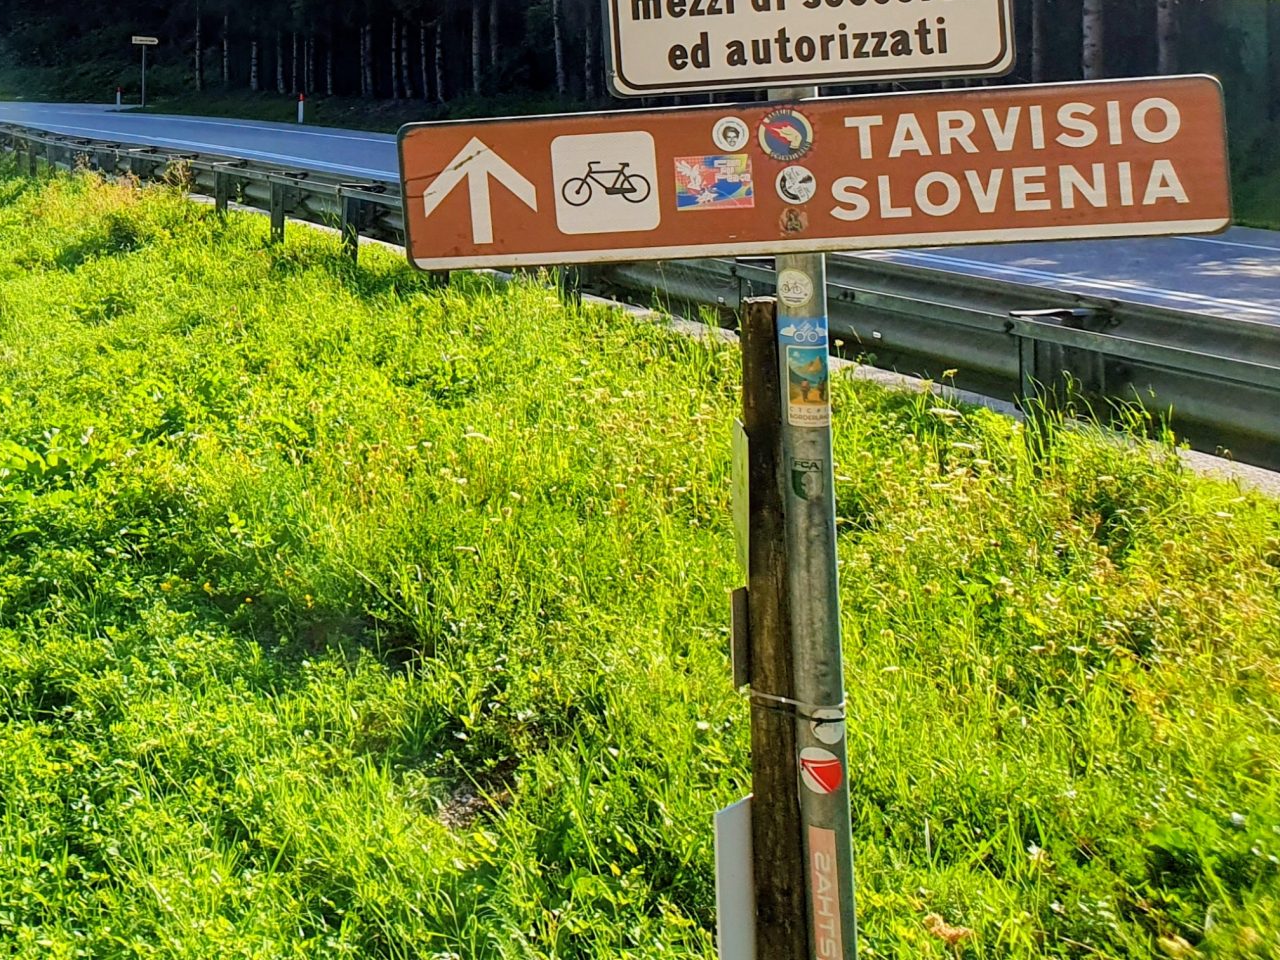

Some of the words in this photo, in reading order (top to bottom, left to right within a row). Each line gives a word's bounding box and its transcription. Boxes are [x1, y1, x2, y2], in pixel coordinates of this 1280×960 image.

[667, 31, 711, 71] ed
[725, 16, 948, 67] autorizzati
[843, 97, 1182, 160] TARVISIO
[830, 159, 1190, 221] SLOVENIA
[794, 461, 820, 470] FCA
